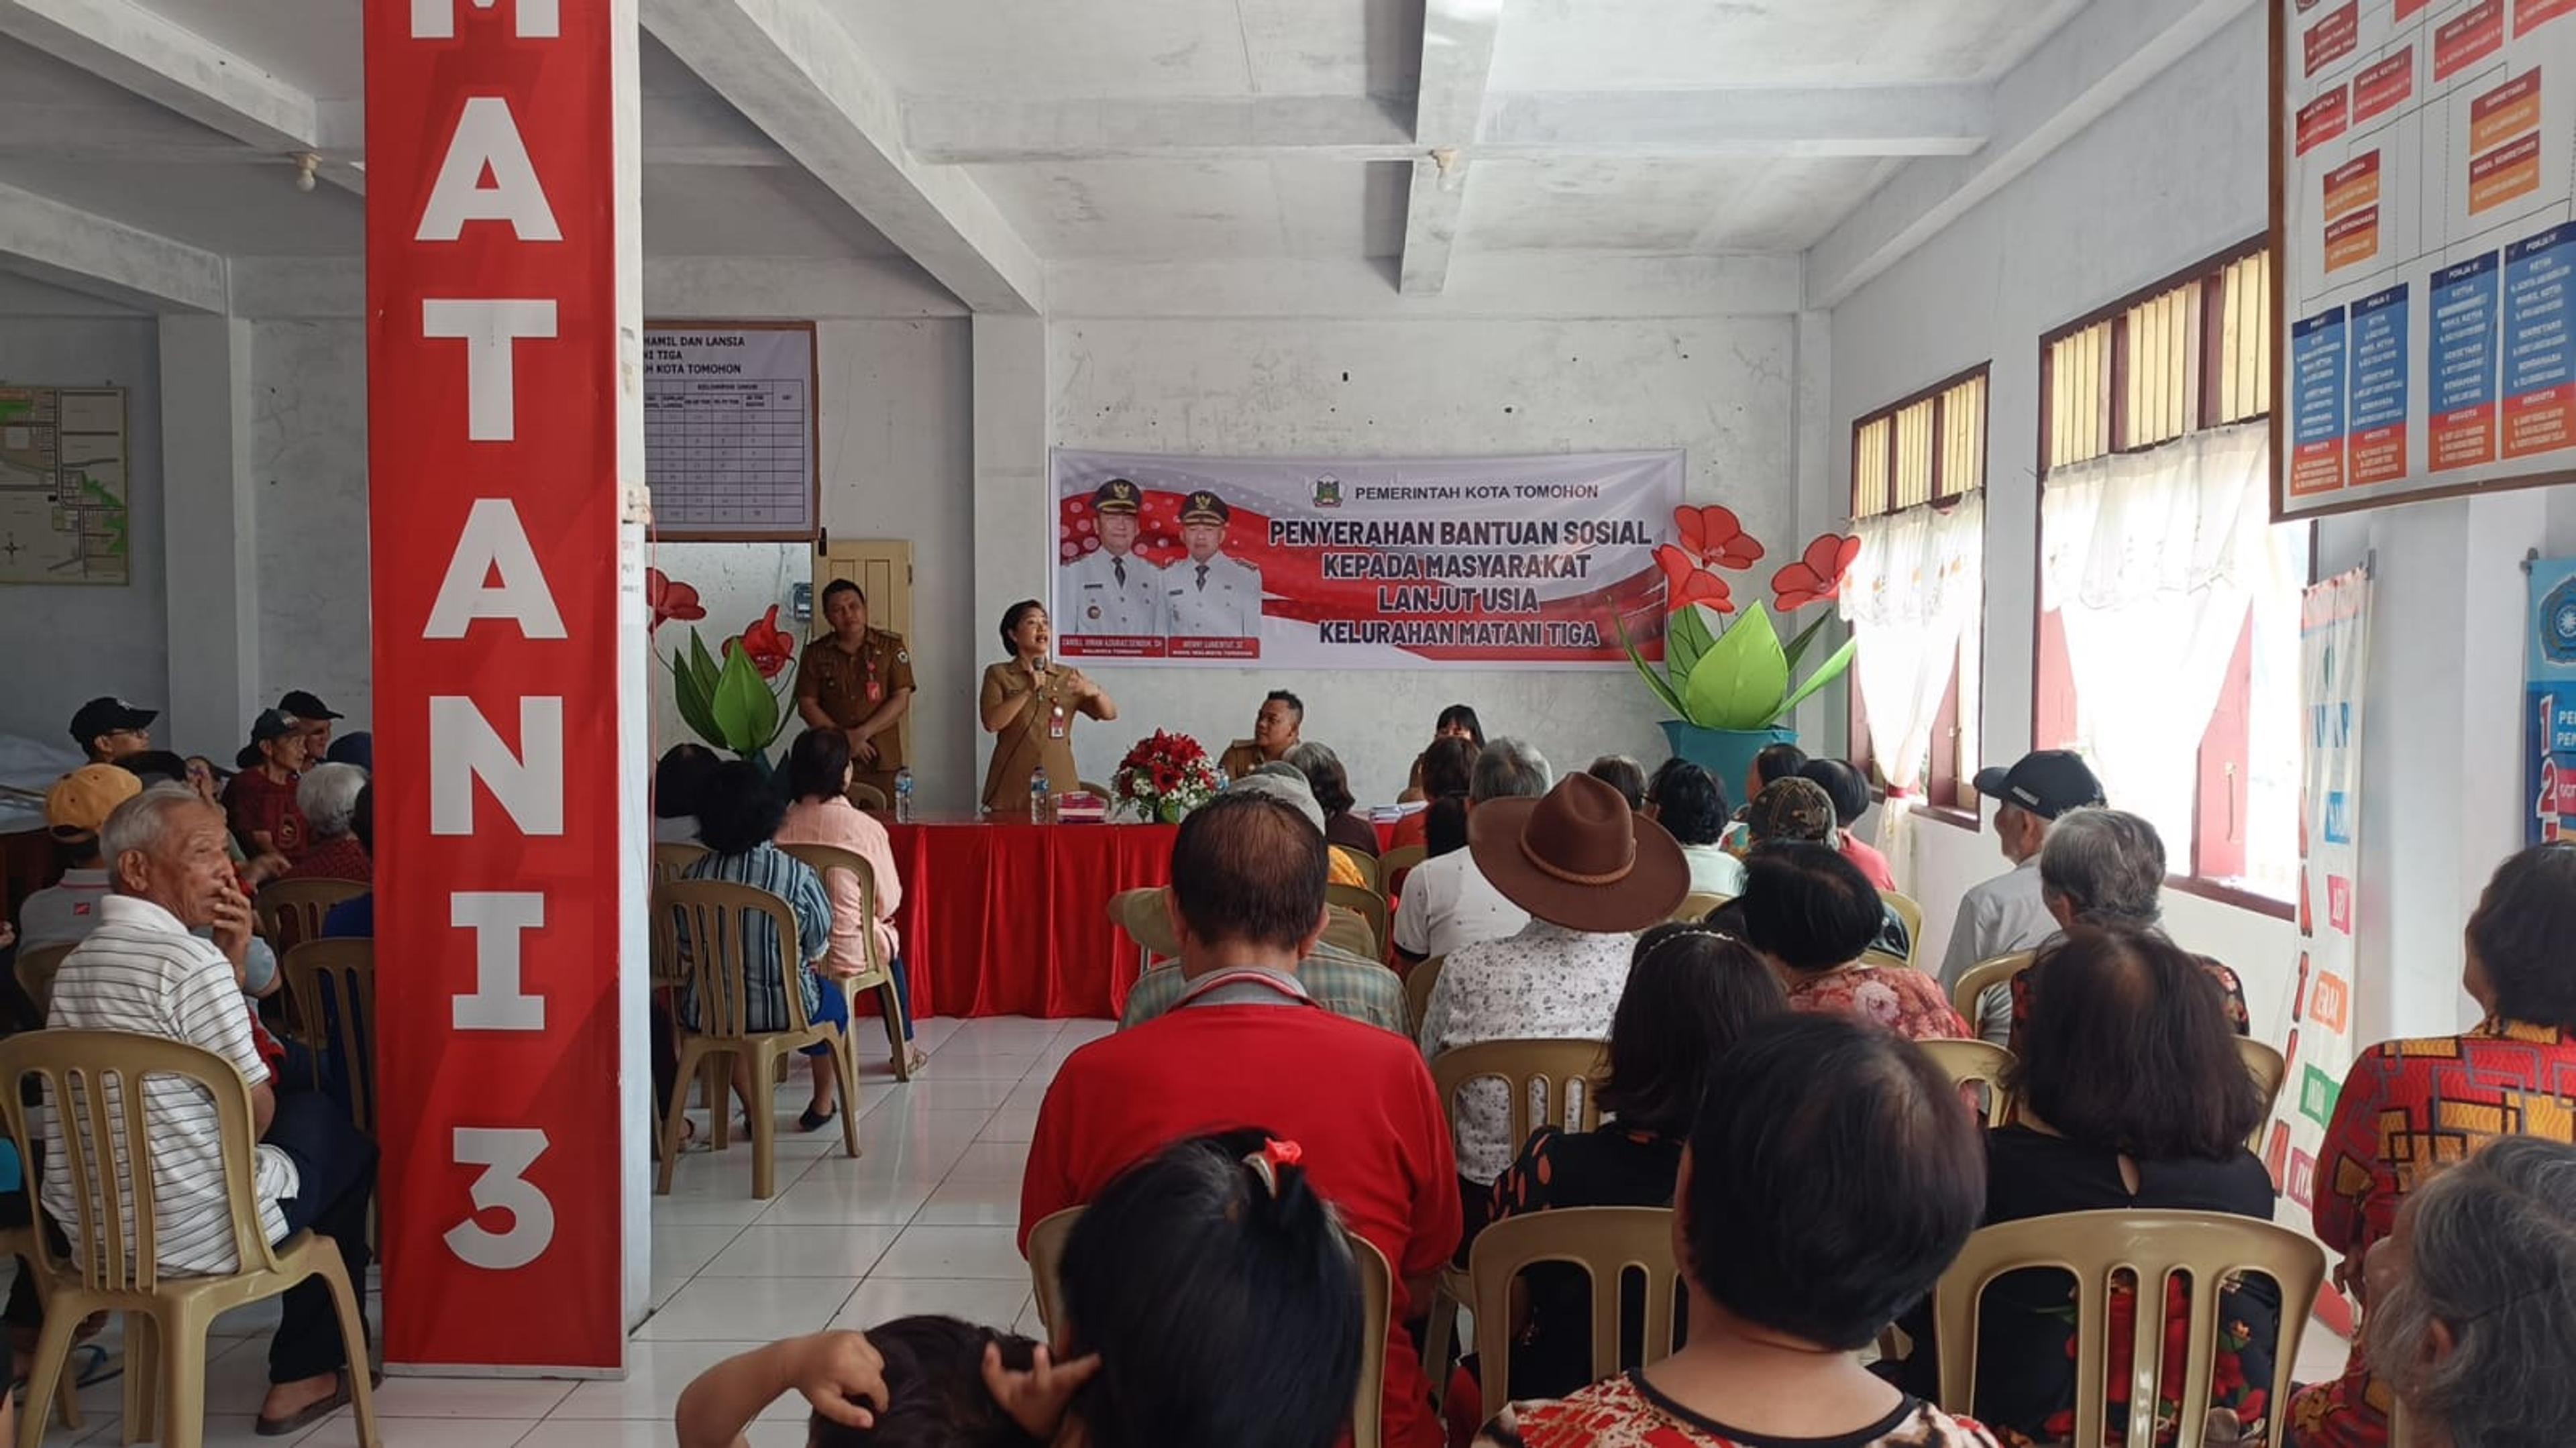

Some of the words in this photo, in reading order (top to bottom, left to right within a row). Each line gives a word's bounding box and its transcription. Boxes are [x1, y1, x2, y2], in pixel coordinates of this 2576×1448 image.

[706, 337, 745, 347] LANSIA
[657, 364, 684, 374] KOTA
[688, 364, 741, 374] TOMOHON
[1355, 486, 1461, 500] PEMERINTAH
[1465, 485, 1511, 499] KOTA
[1513, 484, 1599, 499] TOMOHON
[411, 0, 568, 1029] ATANI
[1269, 519, 1435, 546] PENYERAHAN
[1440, 520, 1558, 546] BANTUAN
[1564, 520, 1653, 545] SOSIAL
[1322, 553, 1421, 579] KEPADA
[1425, 553, 1592, 579] MASYARAKAT
[1378, 587, 1477, 612] LANJUT
[1482, 587, 1540, 612] USIA
[1320, 621, 1457, 645] KELURAHAN
[1458, 622, 1542, 645] MATANI
[1546, 622, 1600, 646] TIGA
[2536, 757, 2557, 818] 2
[441, 1127, 555, 1269] 3
